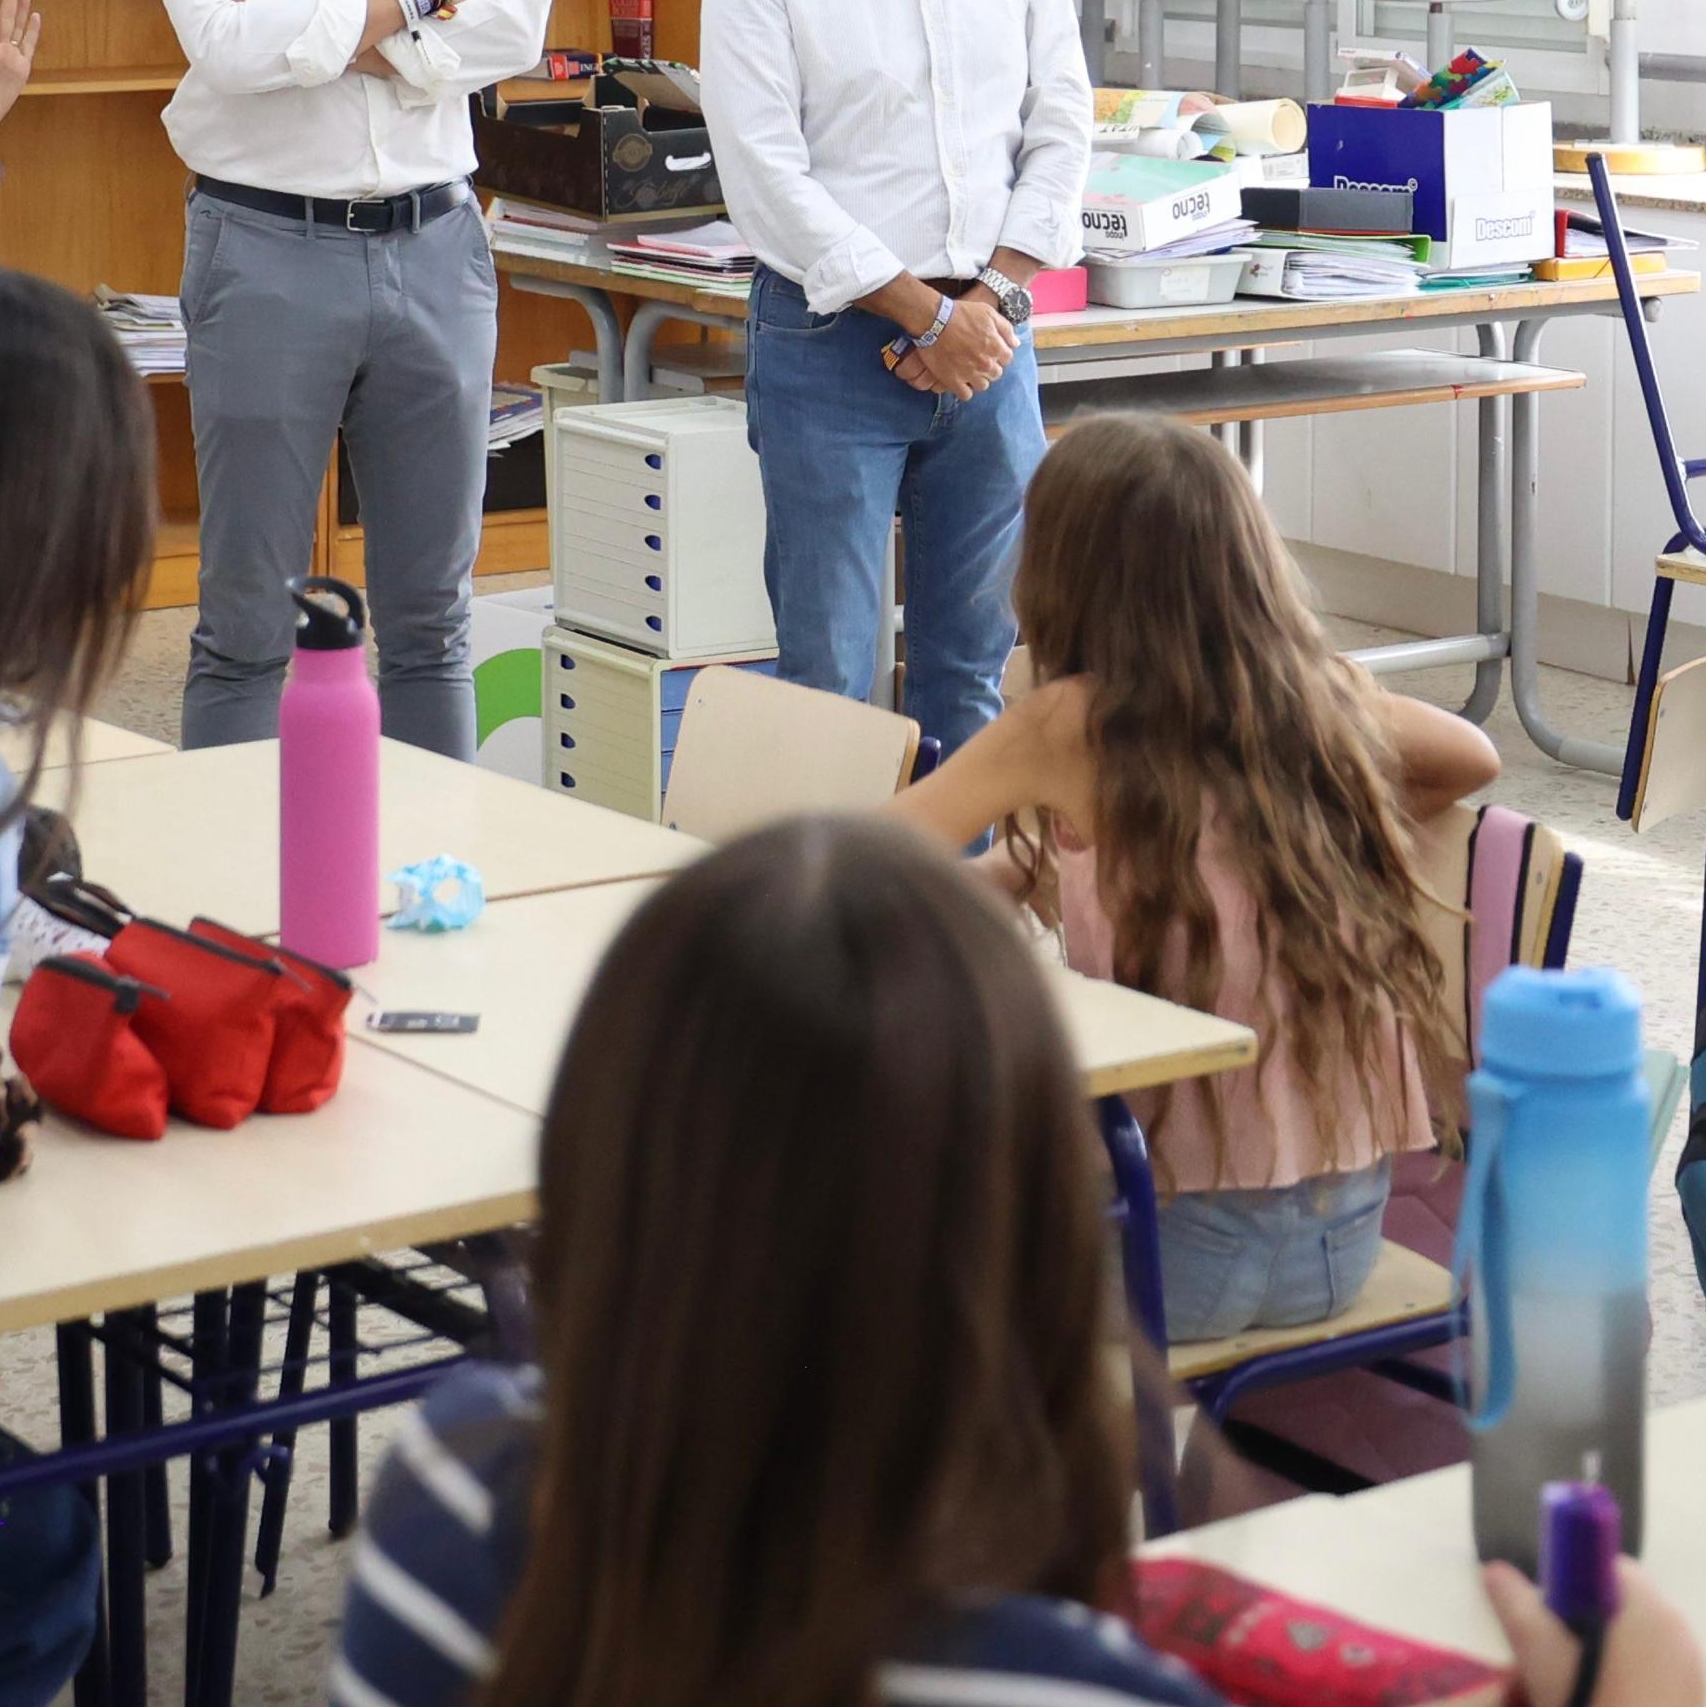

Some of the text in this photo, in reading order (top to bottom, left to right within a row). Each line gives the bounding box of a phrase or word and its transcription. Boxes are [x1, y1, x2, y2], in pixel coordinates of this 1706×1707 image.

[1172, 192, 1210, 220] tecno
[1082, 212, 1128, 238] tecno
[1475, 216, 1533, 242] Descom
